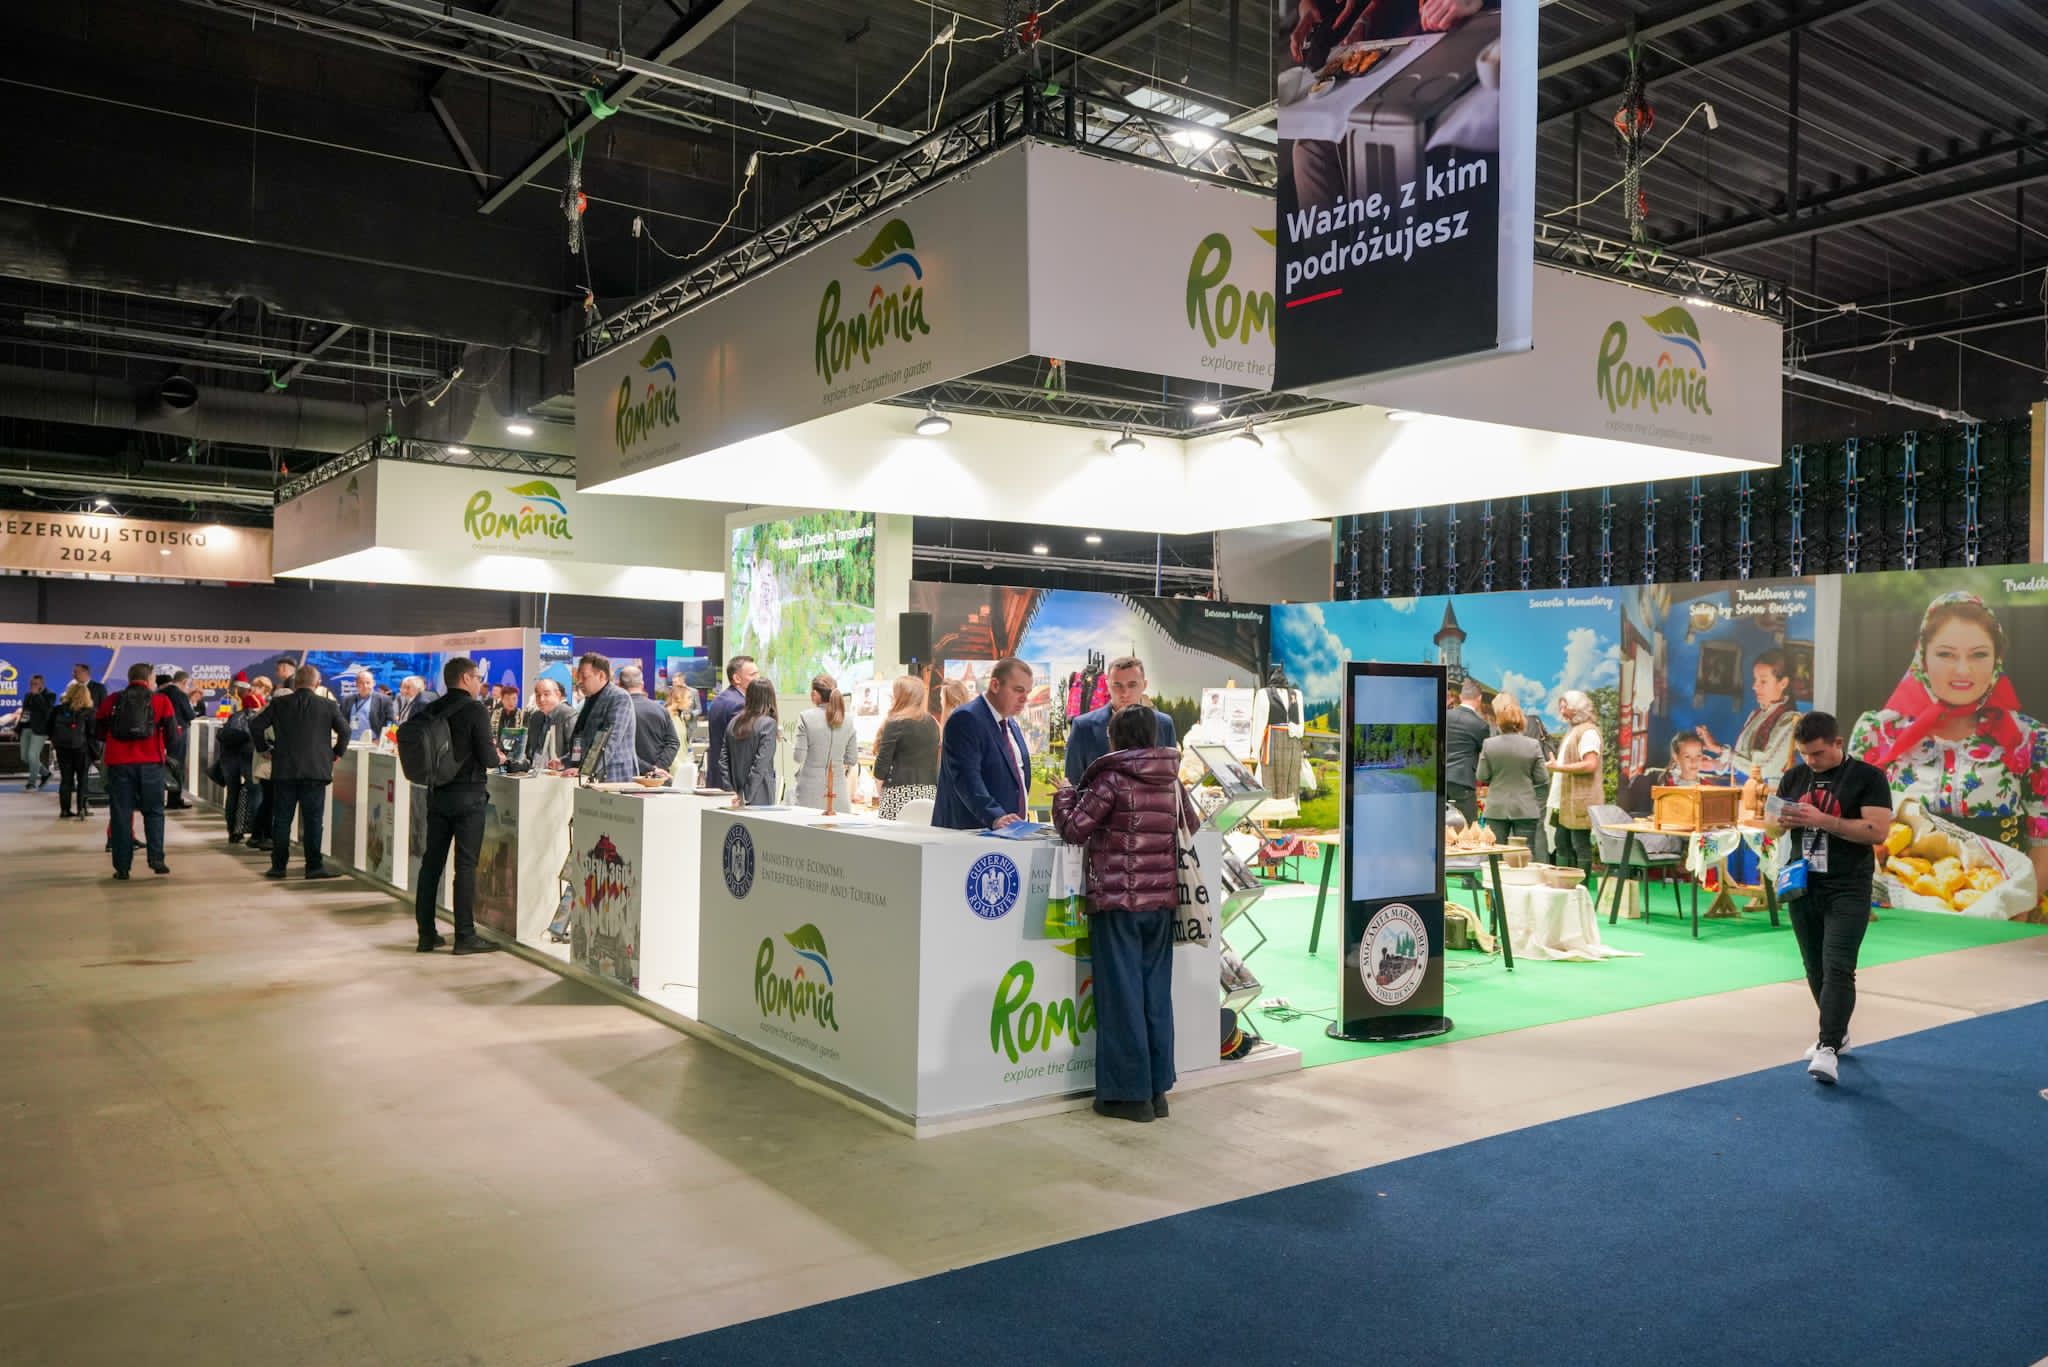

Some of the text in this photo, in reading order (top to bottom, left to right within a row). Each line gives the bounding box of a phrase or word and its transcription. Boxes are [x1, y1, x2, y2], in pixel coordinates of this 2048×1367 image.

[1287, 158, 1488, 244] Ważne, z kim
[1286, 209, 1470, 294] podróżujesz
[816, 280, 931, 385] România
[1201, 353, 1245, 373] explore
[1247, 360, 1265, 376] the
[1597, 320, 1712, 415] România
[615, 376, 680, 451] România
[464, 490, 573, 540] România
[60, 547, 112, 563] 2024
[84, 631, 251, 644] ZAREZERWUJ STOISKO 2024
[191, 664, 231, 673] CAMPER
[970, 855, 1016, 880] GUVERNUL
[754, 937, 838, 1032] România
[1003, 1066, 1045, 1085] explore
[1047, 1060, 1065, 1076] the
